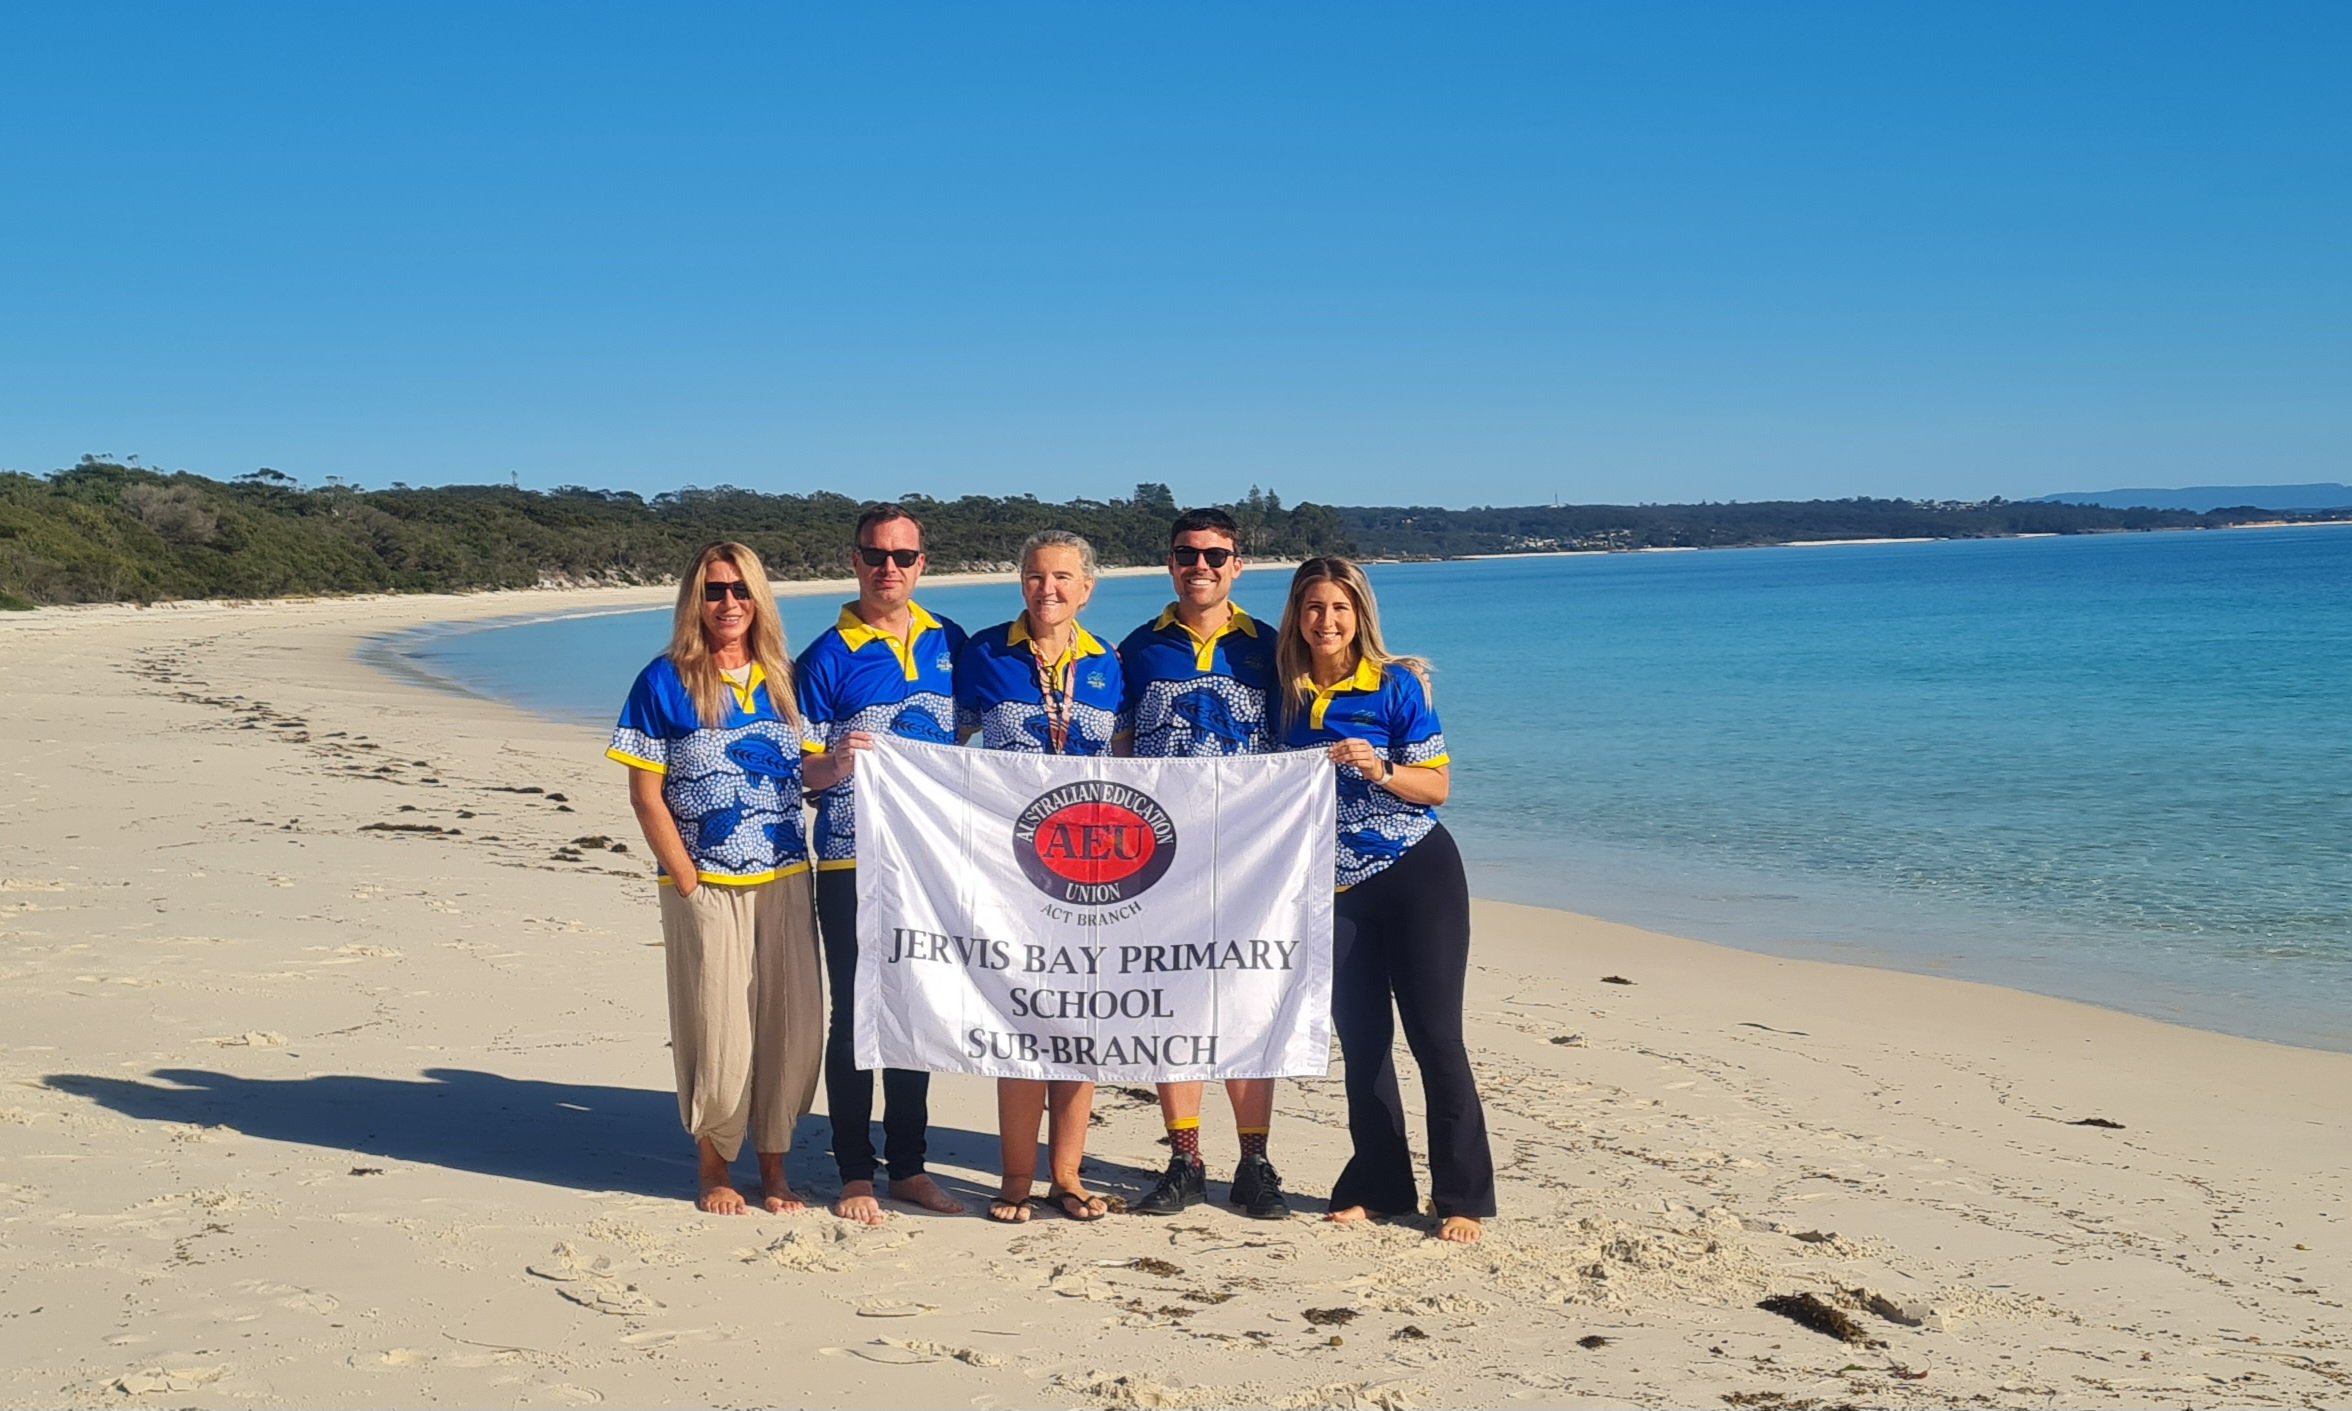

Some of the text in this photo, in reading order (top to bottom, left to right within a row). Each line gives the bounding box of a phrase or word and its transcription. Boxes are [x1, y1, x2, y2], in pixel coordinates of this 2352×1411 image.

[1015, 783, 1174, 845] AUSTRALIAN EDUCATION
[1043, 823, 1146, 860] AEU
[1065, 883, 1121, 902] UNION
[1040, 901, 1142, 926] ACT BRANCH
[888, 927, 1299, 974] JERVIS BAY PRIMARY
[1009, 987, 1174, 1019] SCHOOL
[967, 1028, 1219, 1066] SUB-BRANCH
